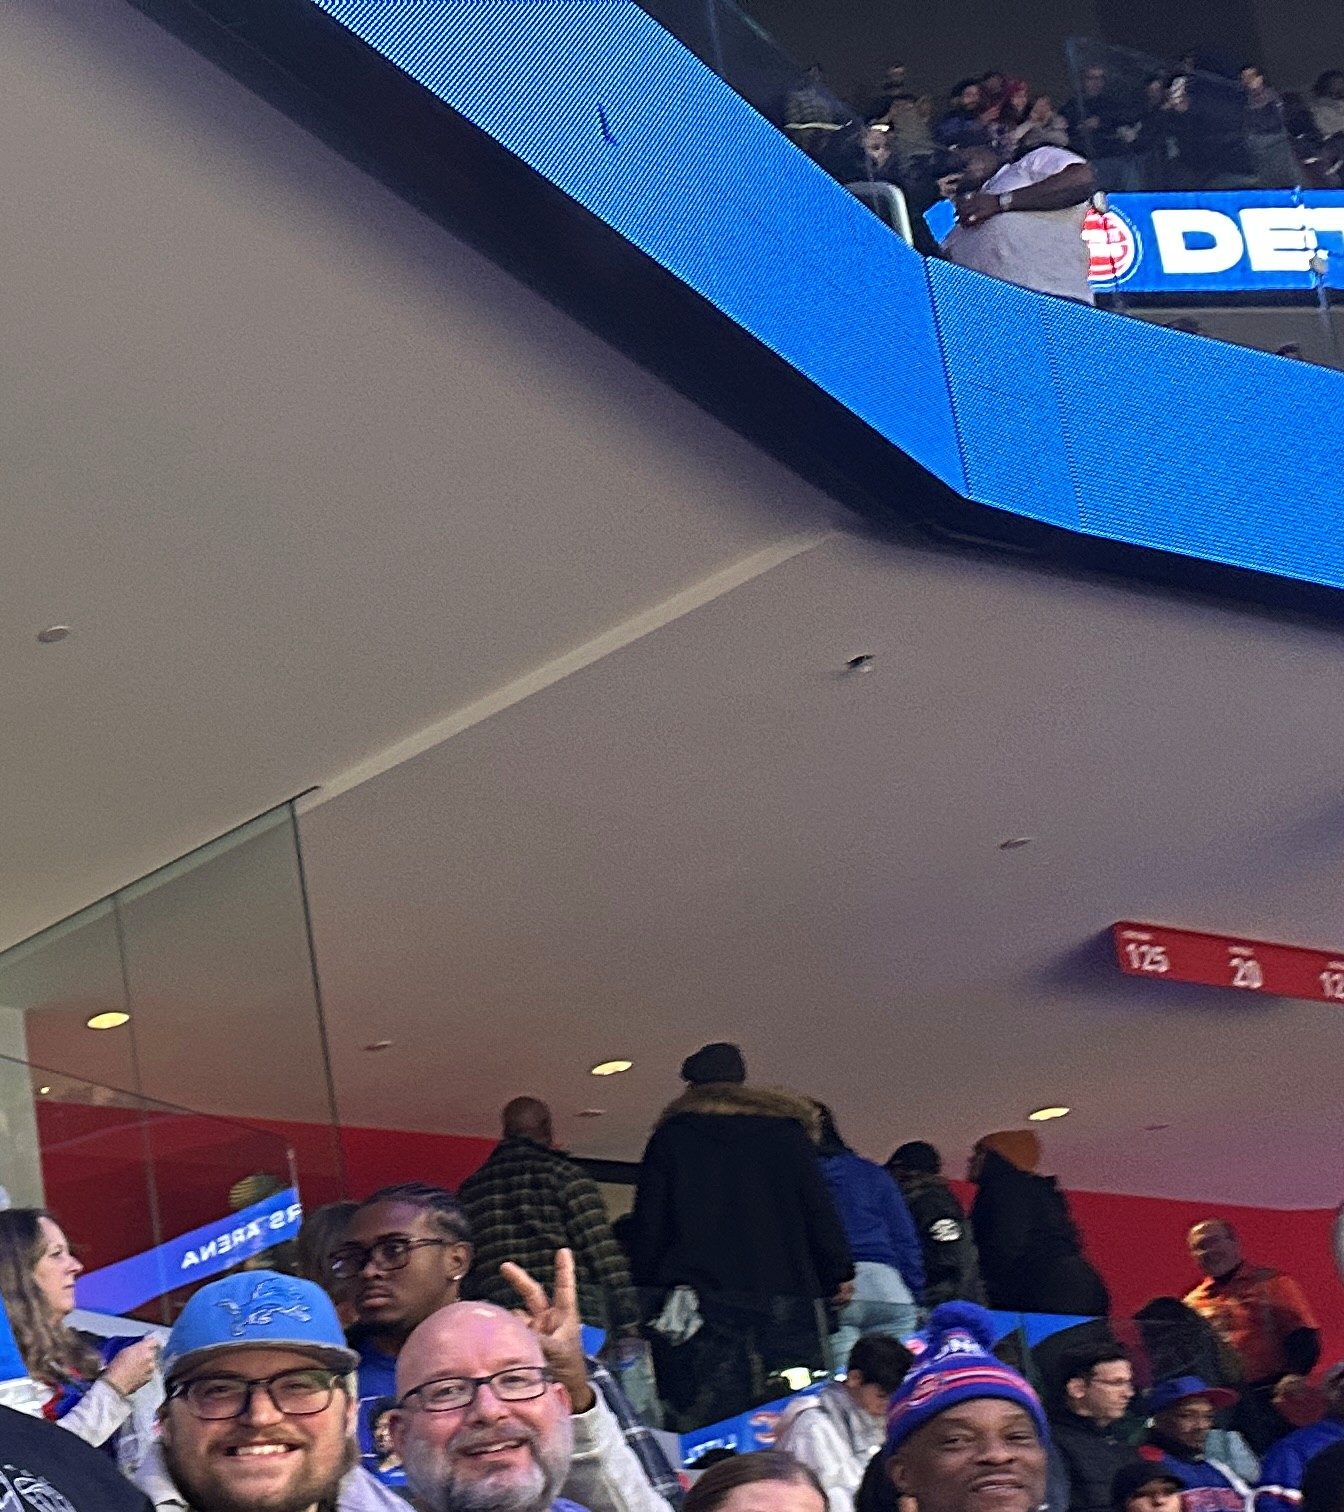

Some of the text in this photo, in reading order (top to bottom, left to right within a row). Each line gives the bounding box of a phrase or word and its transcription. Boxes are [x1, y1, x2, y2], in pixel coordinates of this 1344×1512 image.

[1125, 943, 1170, 973] 125
[1228, 957, 1264, 989] 20
[1319, 971, 1344, 999] 12
